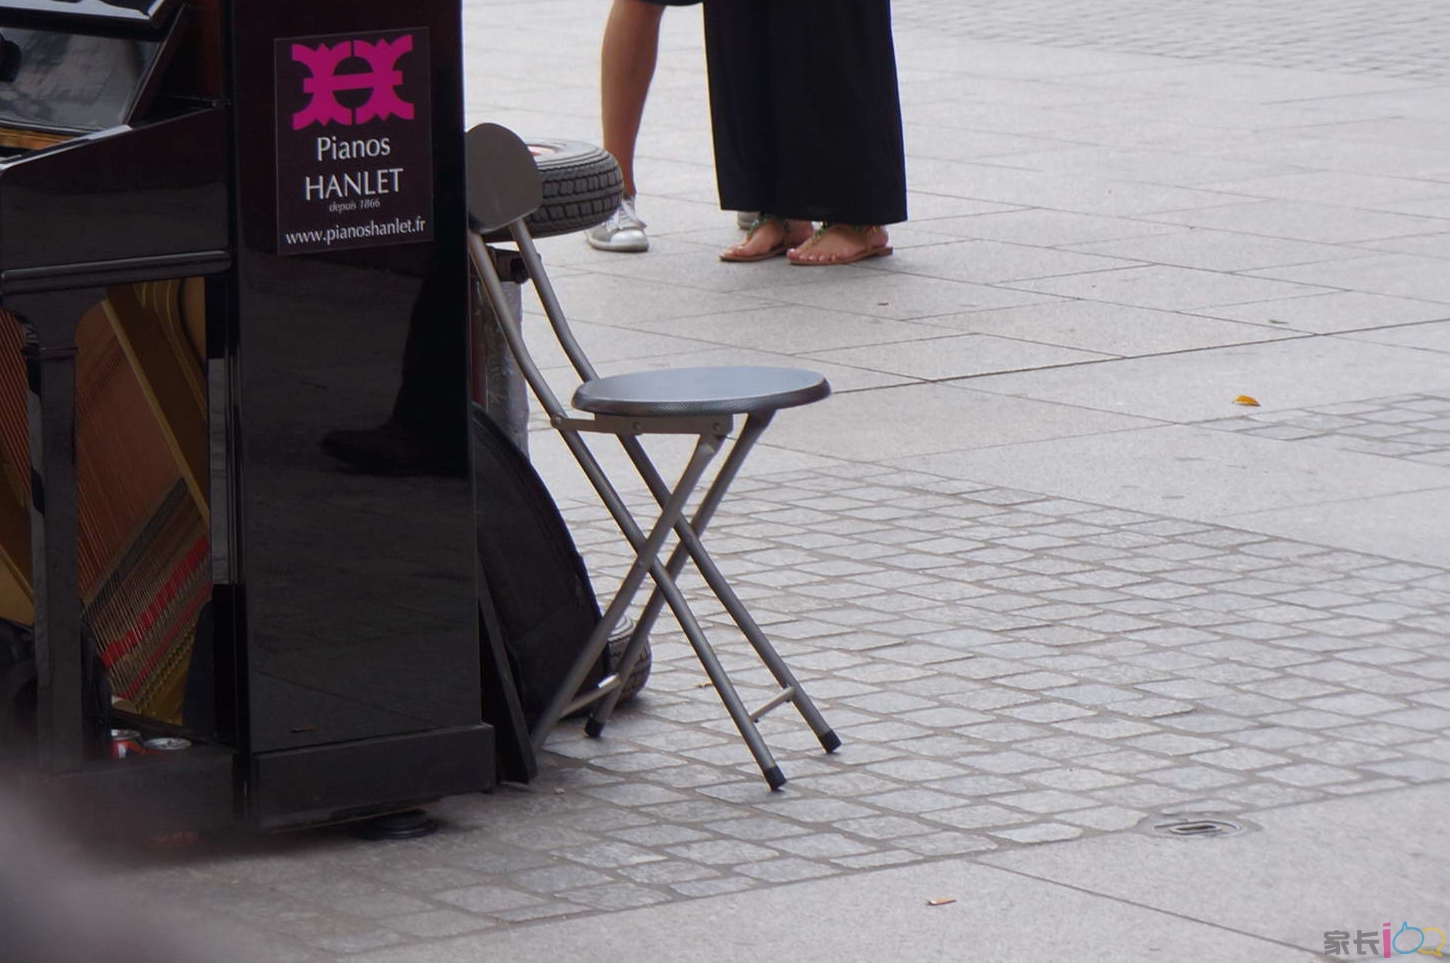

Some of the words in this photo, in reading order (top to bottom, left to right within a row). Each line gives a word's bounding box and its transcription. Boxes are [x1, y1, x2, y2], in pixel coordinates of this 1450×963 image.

[316, 136, 391, 162] Pianos
[305, 168, 404, 201] HANLET
[328, 200, 357, 214] depuis
[359, 198, 381, 210] 1866
[285, 215, 426, 246] www.pianoshanlet.fr
